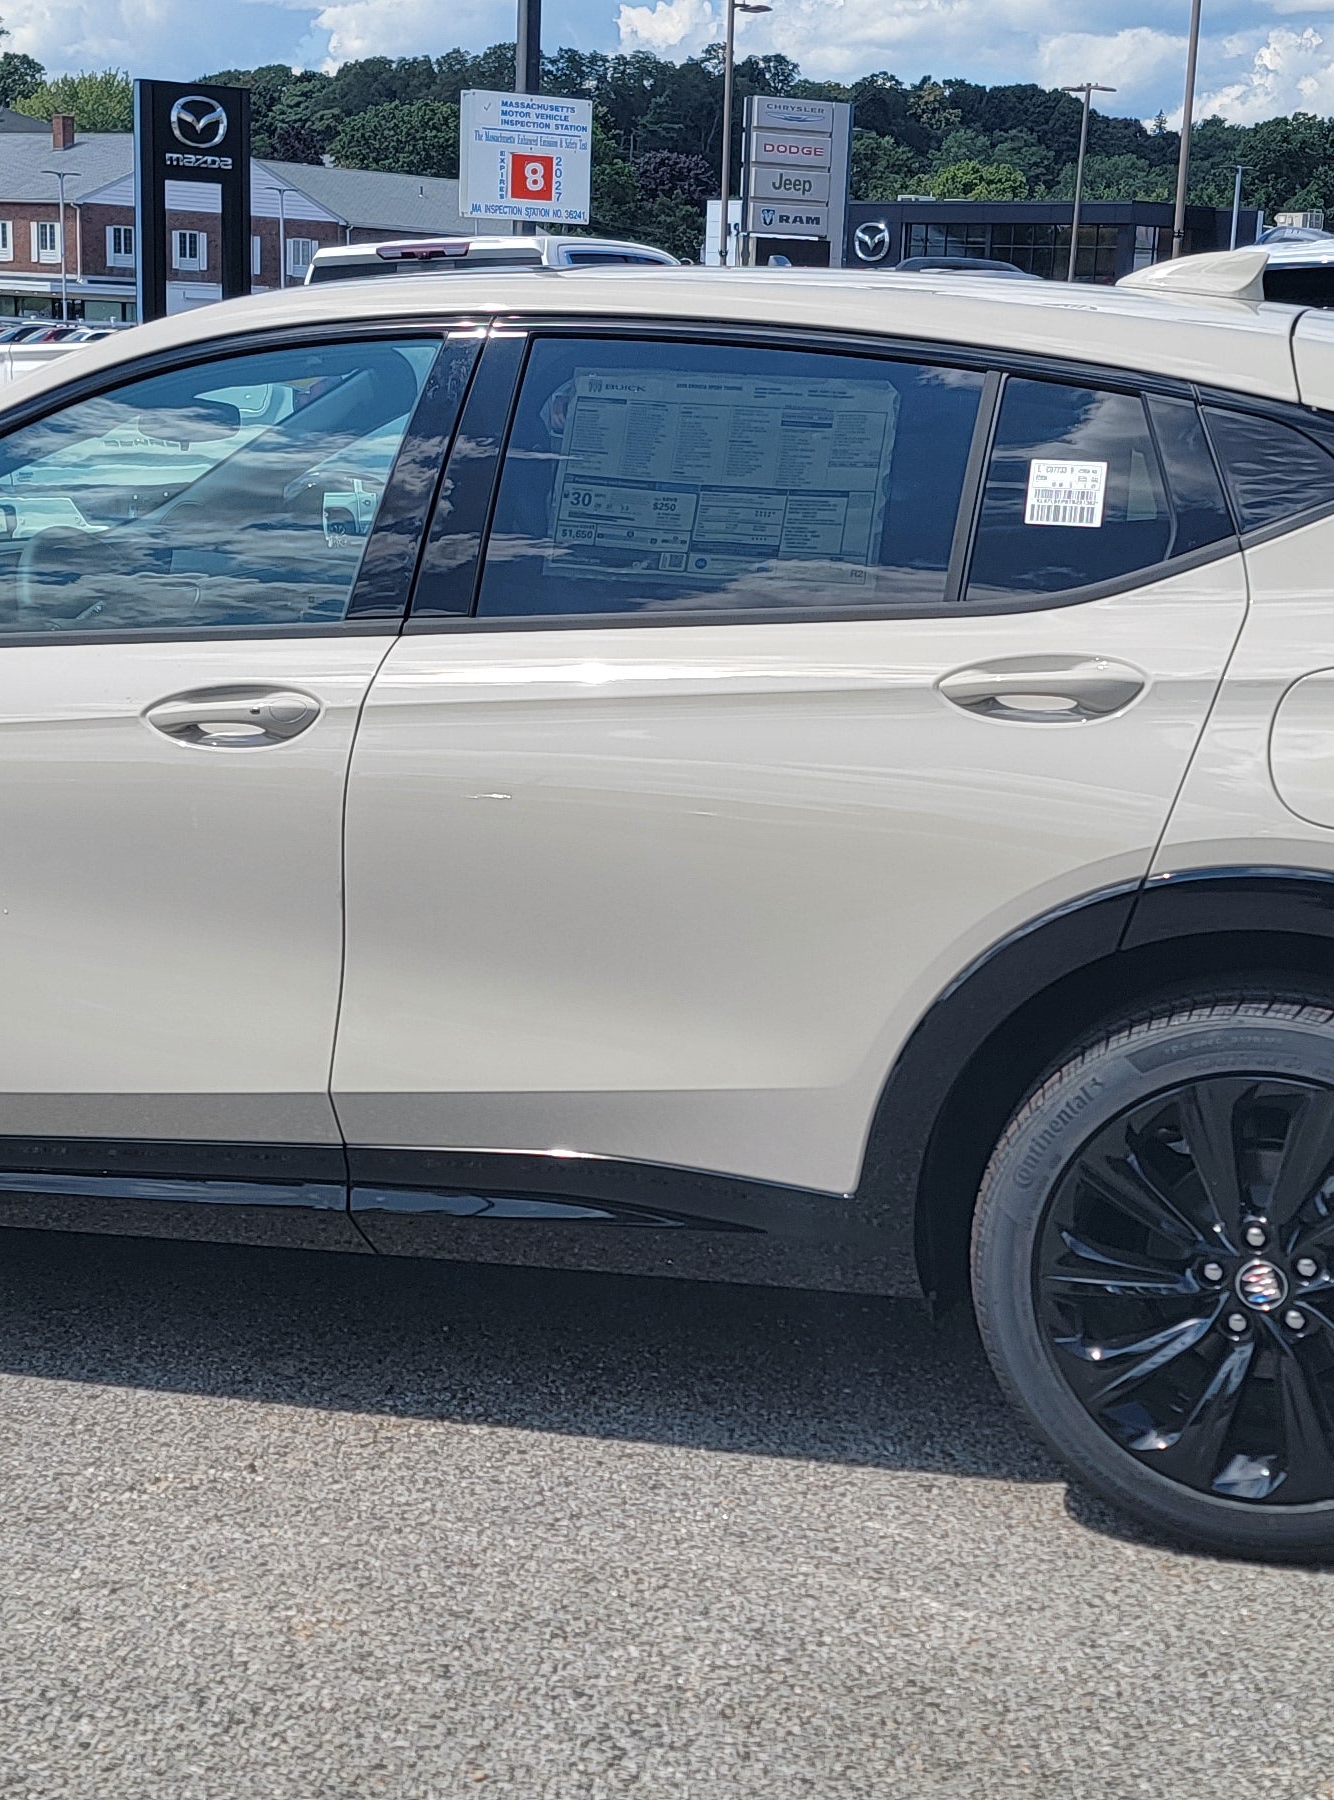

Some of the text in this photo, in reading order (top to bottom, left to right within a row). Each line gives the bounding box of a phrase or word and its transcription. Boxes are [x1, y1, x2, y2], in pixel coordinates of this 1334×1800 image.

[501, 100, 576, 114] MASSACHUSETTS
[766, 103, 825, 114] CHRYSLER
[501, 109, 569, 122] MOTOR VEHICLE
[501, 119, 588, 133] INSPECTION STATION
[474, 129, 484, 141] The
[763, 143, 824, 157] DODGE
[524, 161, 545, 191] 8
[771, 172, 813, 196] Jeep
[471, 203, 482, 214] MA
[484, 204, 523, 216] INSPECTION
[524, 206, 550, 218] STATION
[552, 208, 564, 218] NO.
[778, 214, 821, 226] RAM
[605, 383, 647, 393] BUICK
[570, 491, 593, 507] 30
[652, 502, 677, 512] $250
[561, 529, 594, 540] $1,650
[1012, 1085, 1096, 1189] Continental
